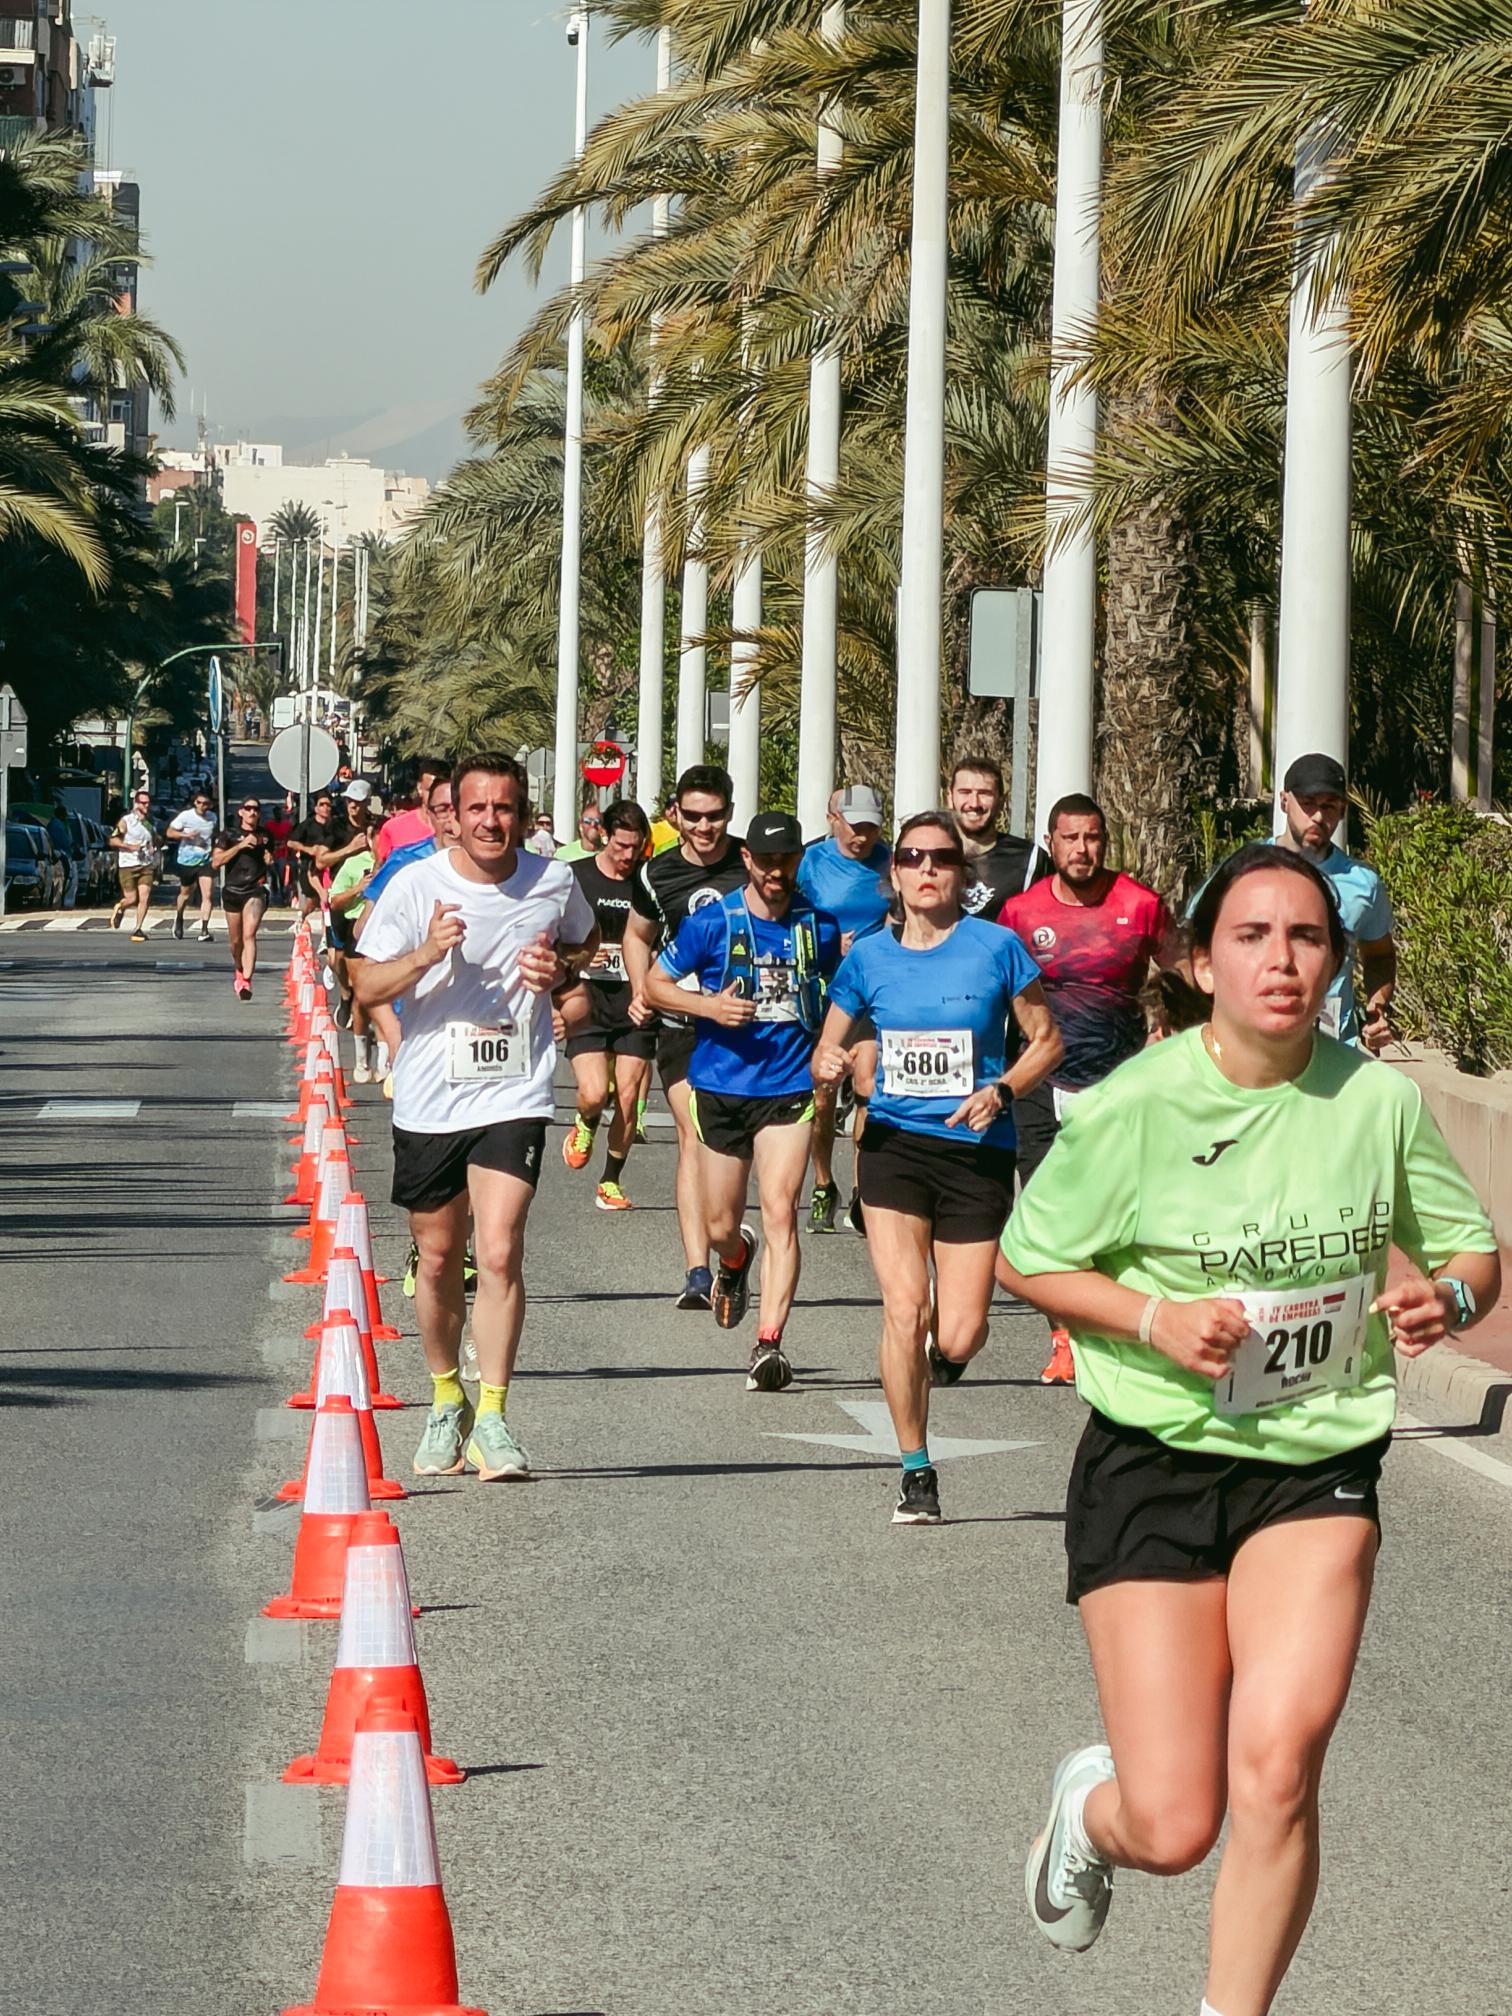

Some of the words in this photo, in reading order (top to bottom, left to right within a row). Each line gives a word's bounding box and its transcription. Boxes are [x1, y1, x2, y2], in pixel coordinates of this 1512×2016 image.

[469, 1038, 509, 1063] 106
[903, 1051, 949, 1076] 680
[1193, 1202, 1389, 1246] GRUPO
[1200, 1223, 1389, 1272] PAREDES
[1264, 1320, 1332, 1374] 210
